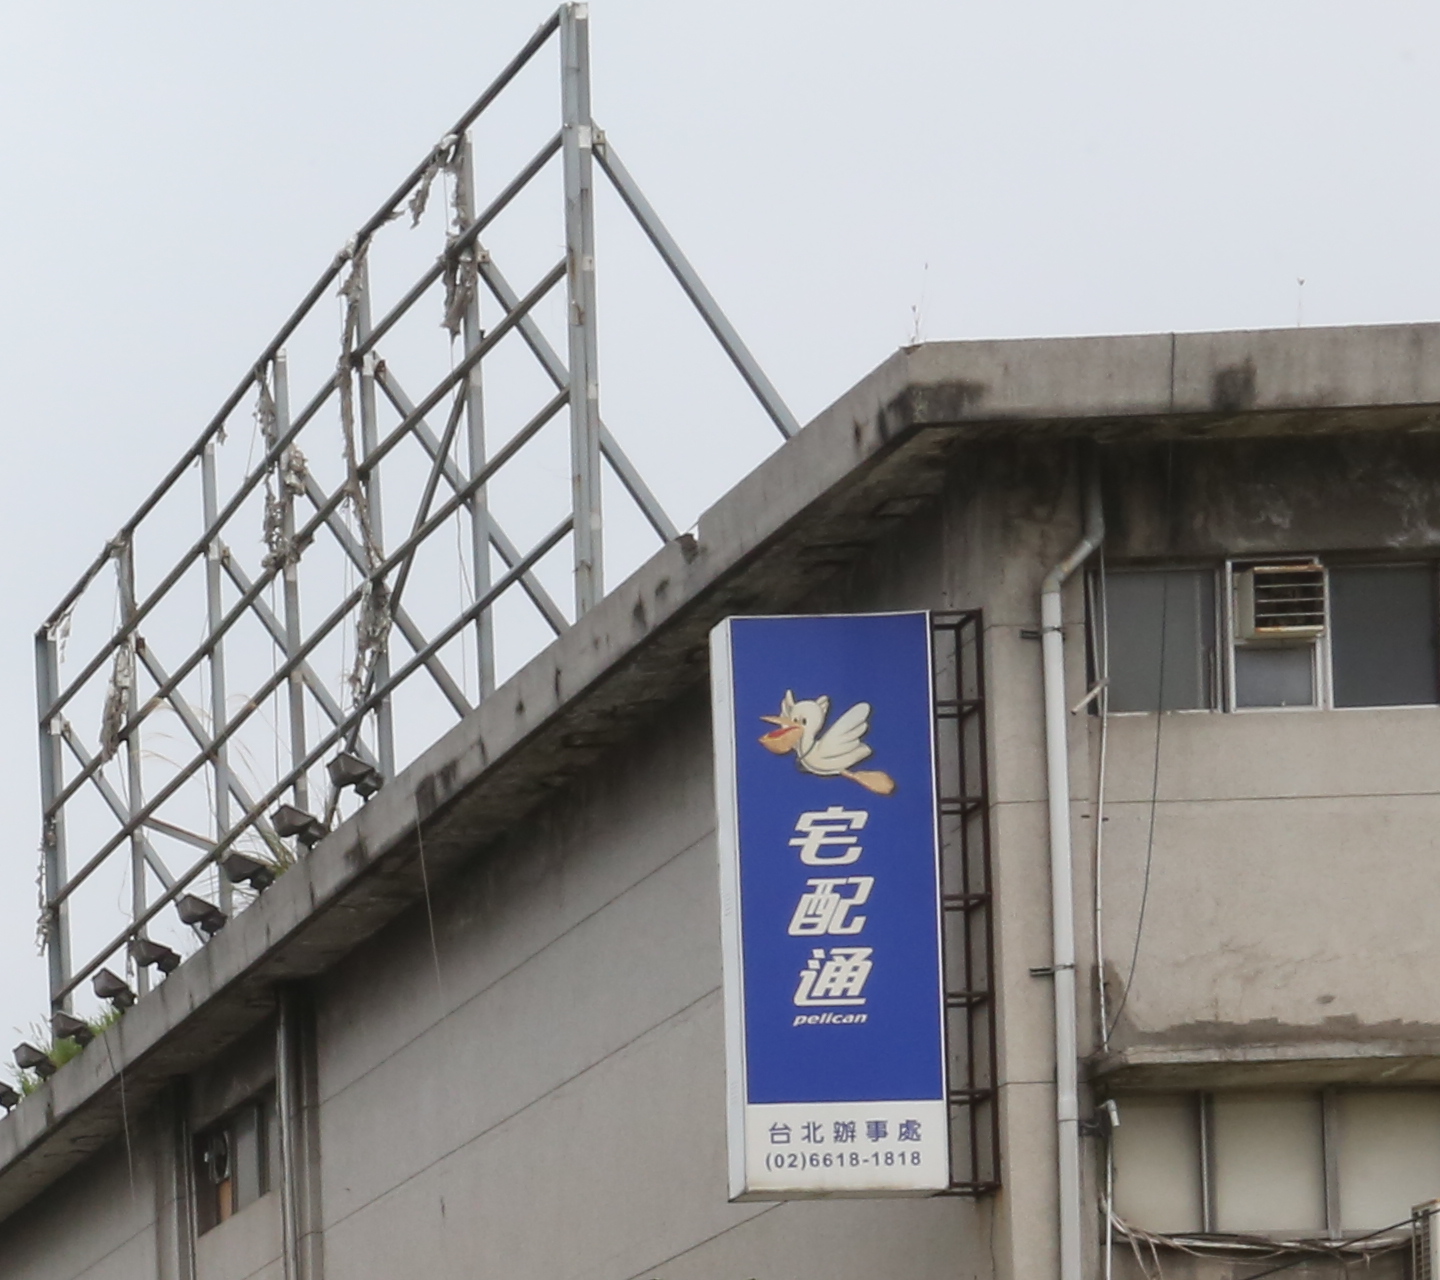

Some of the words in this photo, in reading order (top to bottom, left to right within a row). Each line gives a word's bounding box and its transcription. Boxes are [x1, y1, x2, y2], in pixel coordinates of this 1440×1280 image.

[788, 806, 874, 1006] 宅配通
[792, 1013, 868, 1027] pelican
[768, 1119, 922, 1145] 台北辦事處
[765, 1151, 922, 1172] (02)6618-1818
